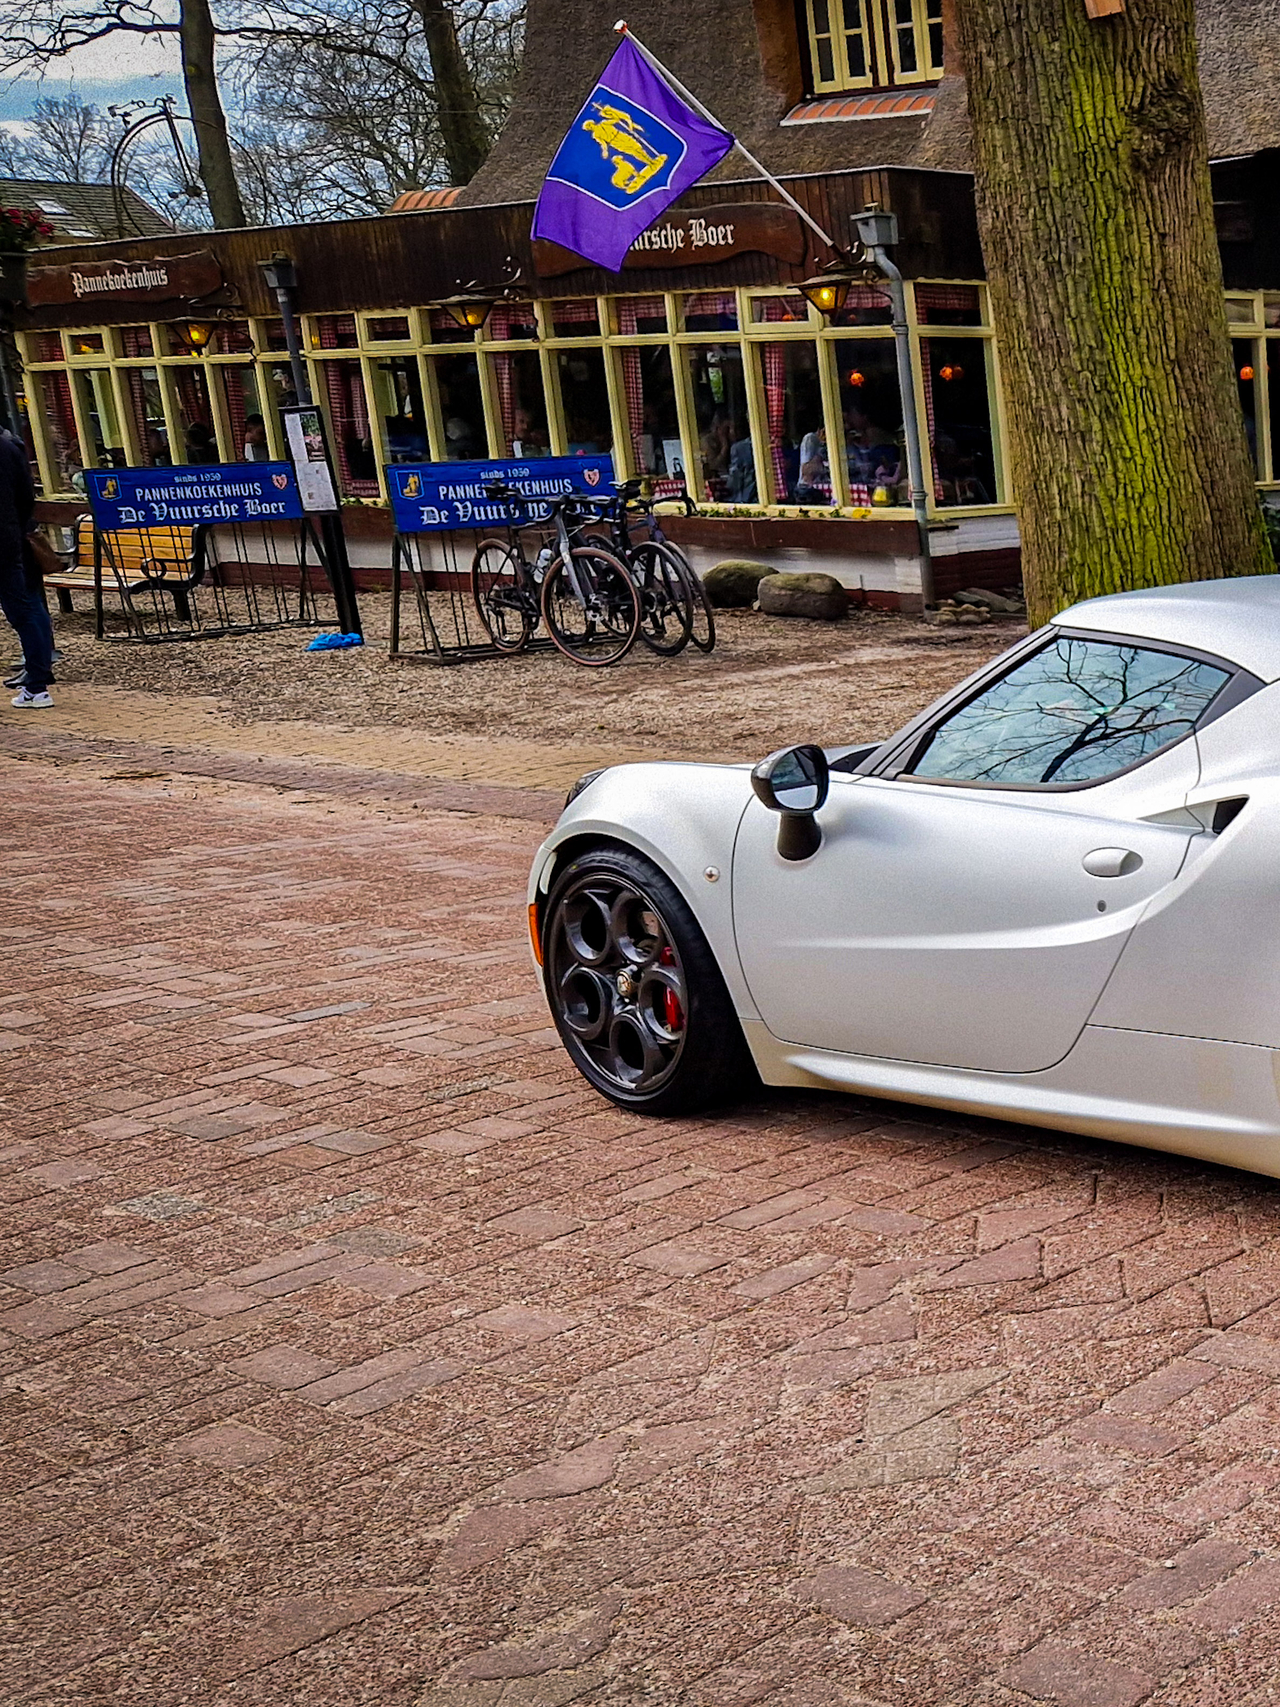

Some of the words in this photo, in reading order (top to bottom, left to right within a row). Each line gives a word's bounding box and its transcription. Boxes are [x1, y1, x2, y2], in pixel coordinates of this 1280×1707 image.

[688, 218, 735, 251] Boer
[70, 265, 168, 298] Pannekoekenhuis
[135, 483, 262, 501] PANNENKOEKENHUIS
[117, 506, 145, 524] De
[149, 501, 239, 520] Vuursche
[244, 499, 286, 517] Boer
[419, 506, 449, 525] De
